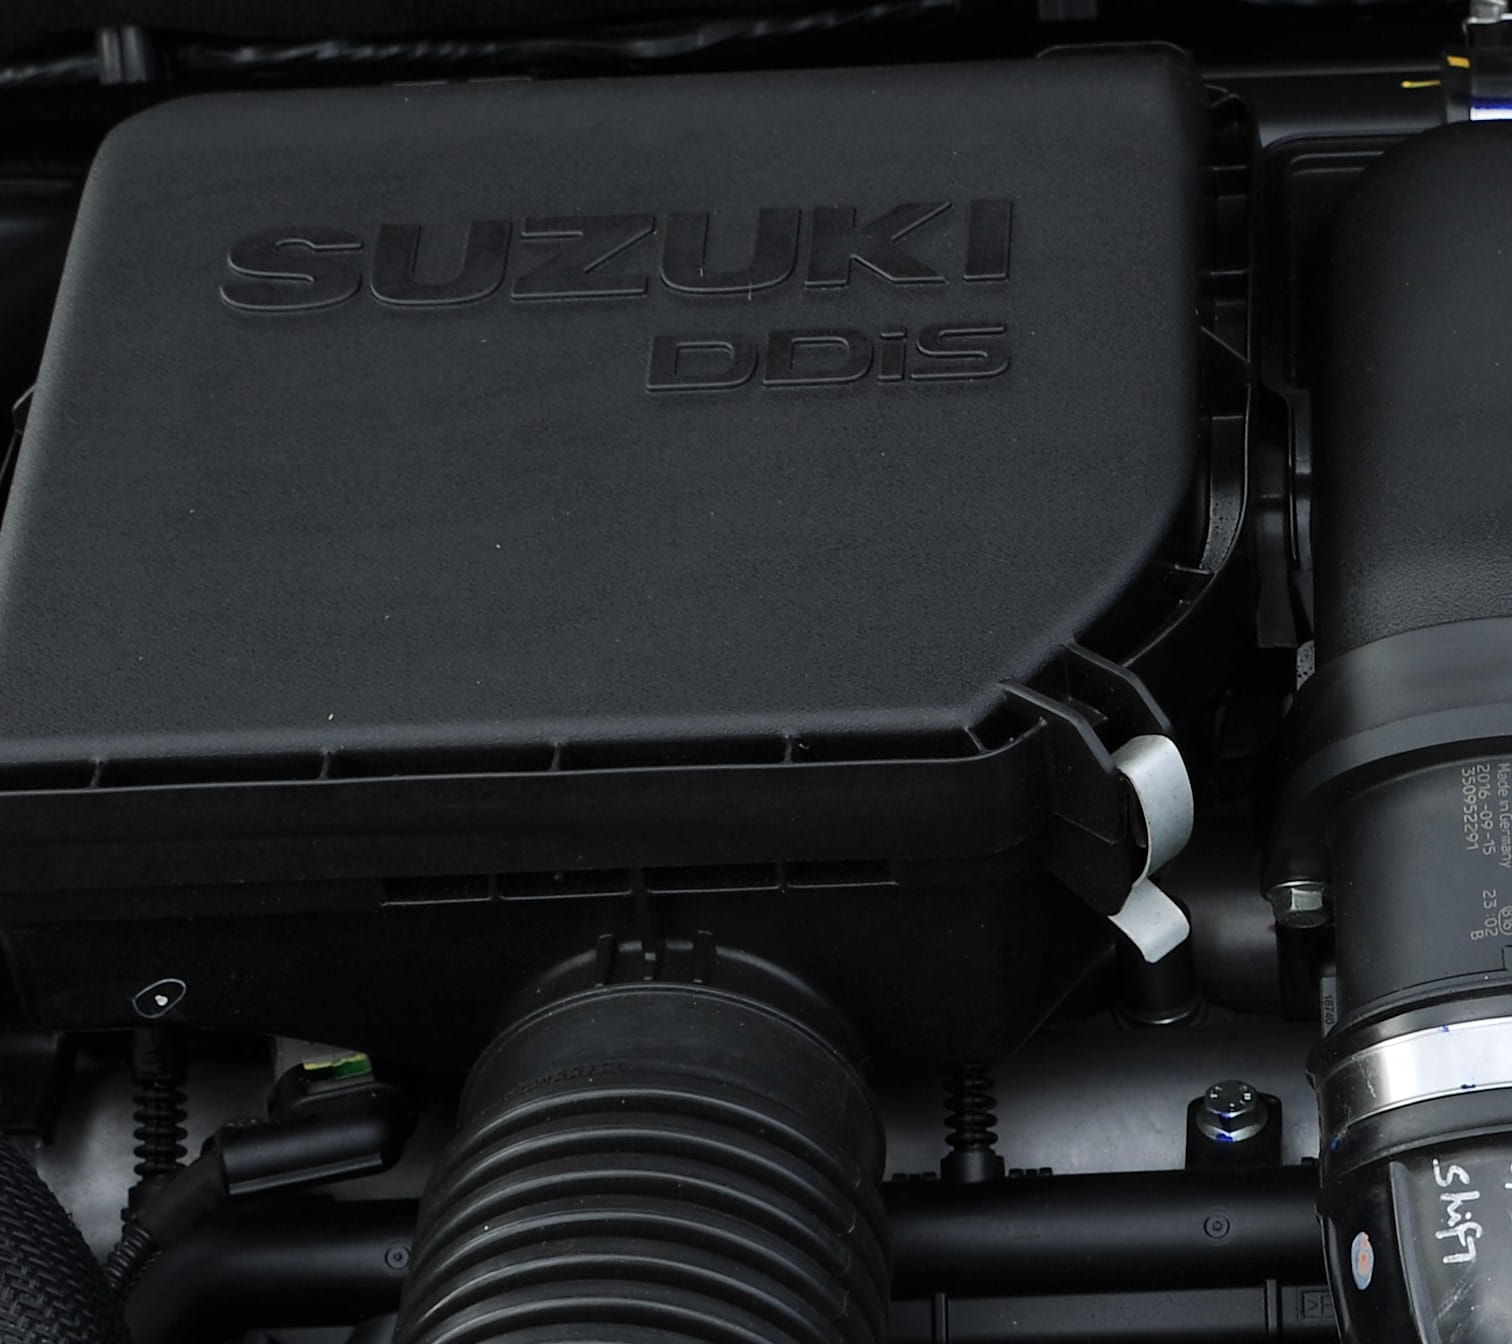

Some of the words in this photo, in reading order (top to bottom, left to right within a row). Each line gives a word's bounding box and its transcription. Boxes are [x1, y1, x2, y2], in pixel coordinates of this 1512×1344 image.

[221, 199, 1013, 313] SUZUKI
[645, 322, 1013, 393] DDiS
[1461, 767, 1478, 849] 350952291
[1496, 763, 1510, 796] Made
[1498, 812, 1512, 868] Germany
